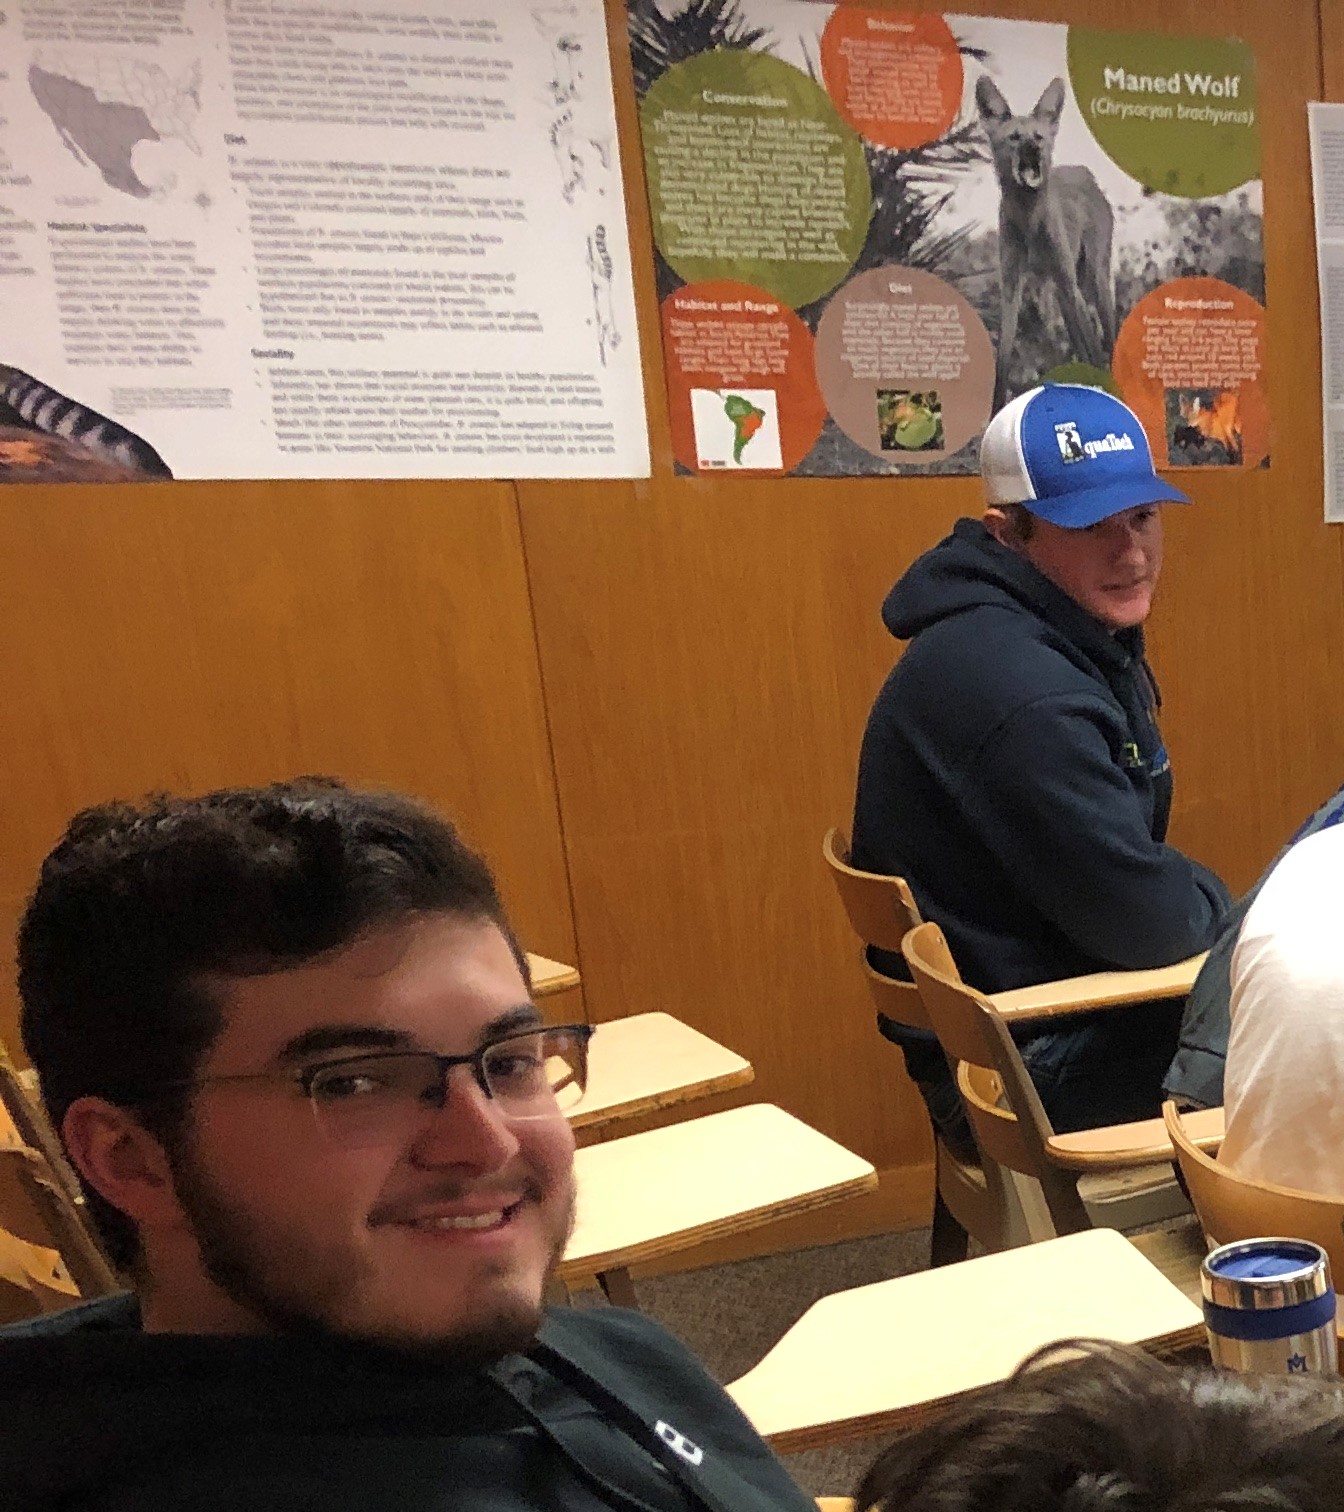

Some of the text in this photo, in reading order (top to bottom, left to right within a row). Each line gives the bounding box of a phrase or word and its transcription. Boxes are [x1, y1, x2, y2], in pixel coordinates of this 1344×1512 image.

[1103, 65, 1241, 99] Maned Wolf
[674, 298, 779, 317] Habitat and Range
